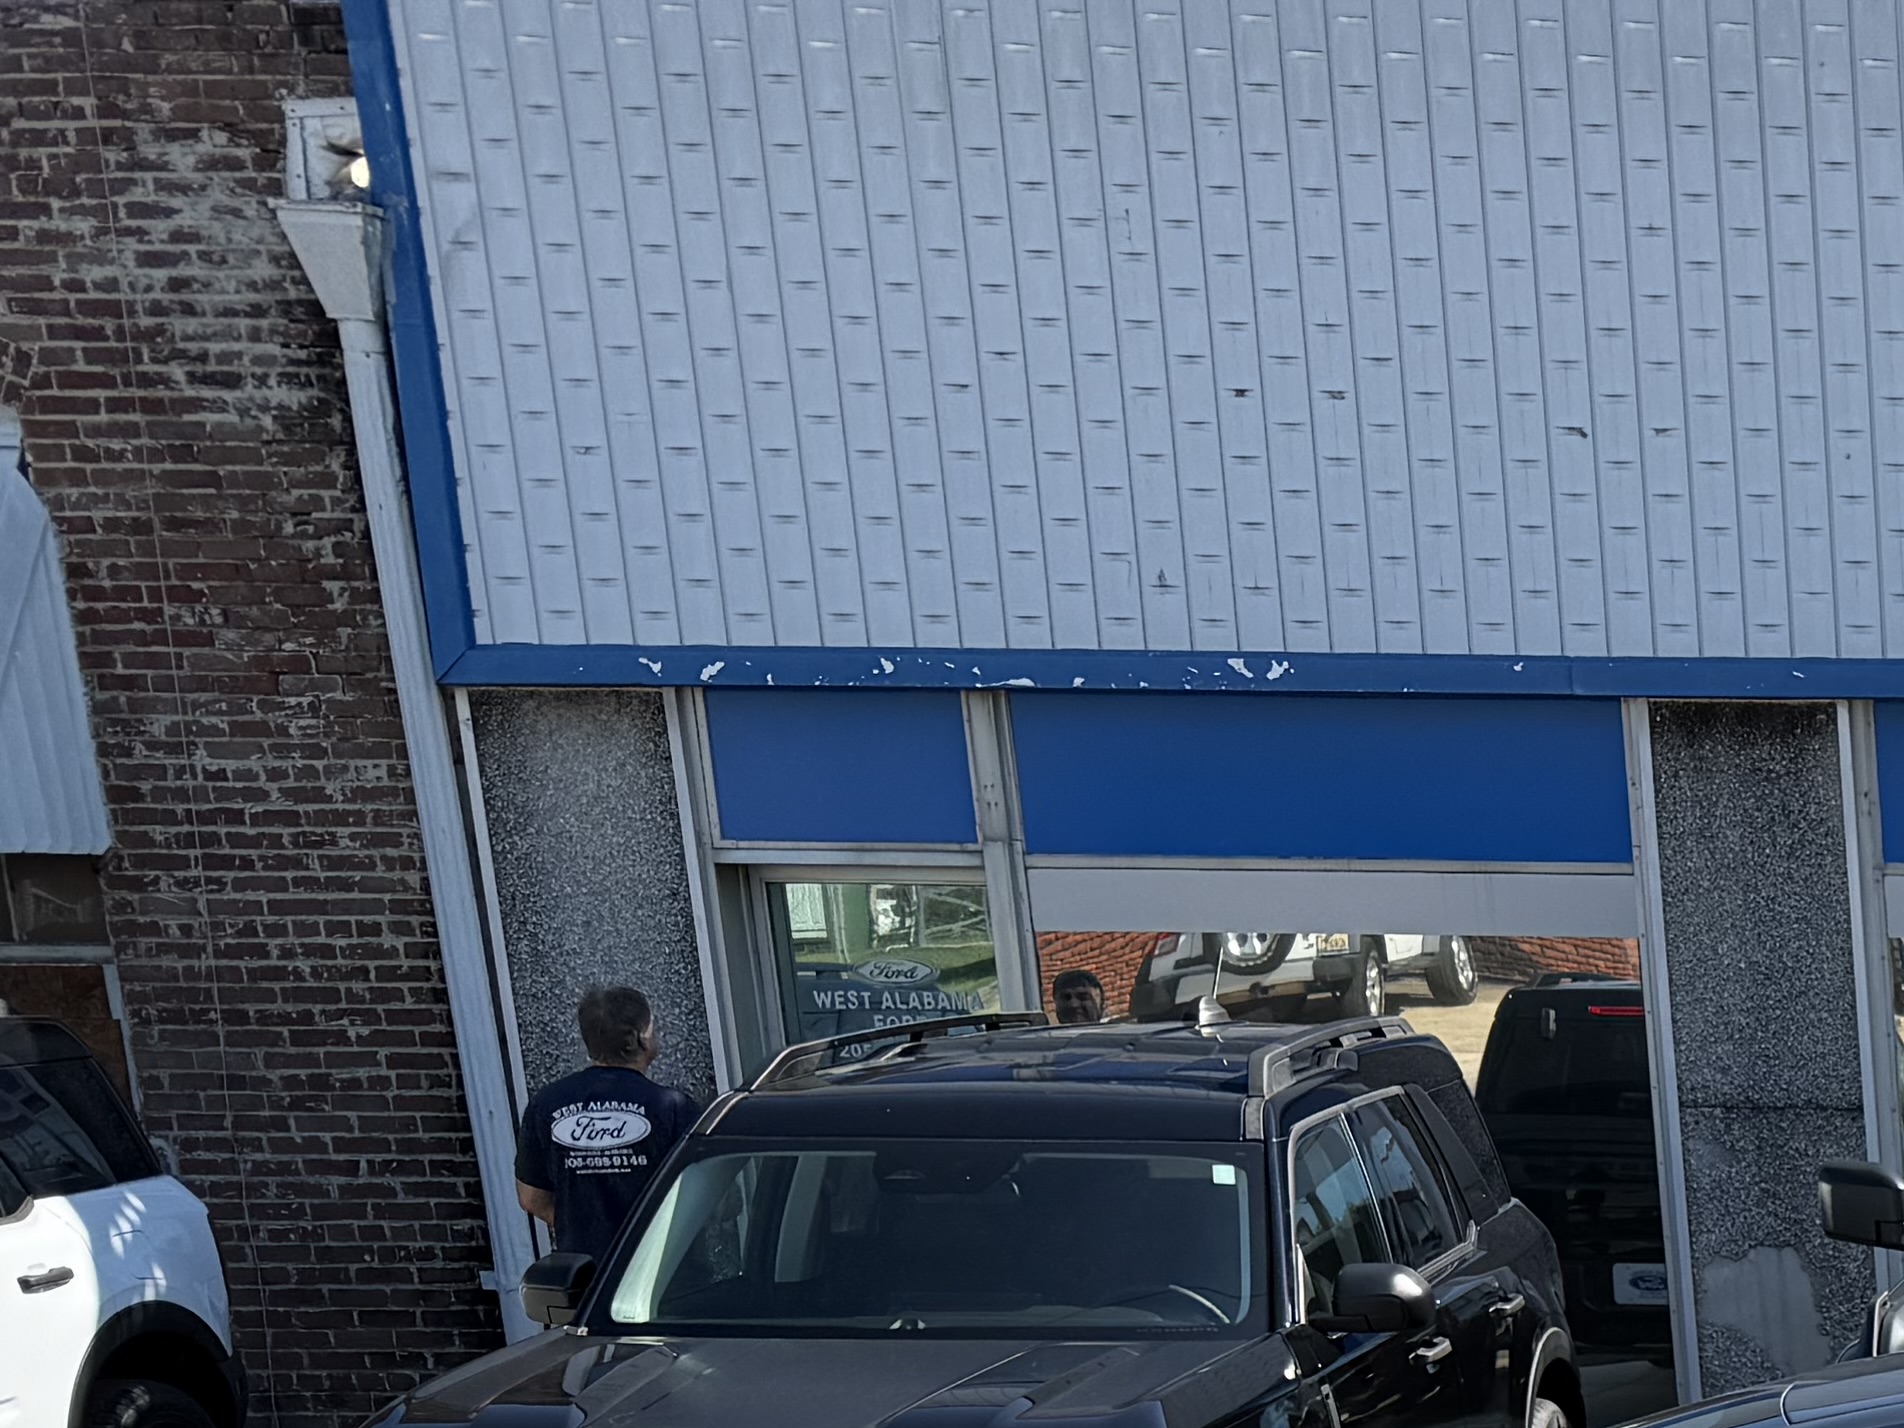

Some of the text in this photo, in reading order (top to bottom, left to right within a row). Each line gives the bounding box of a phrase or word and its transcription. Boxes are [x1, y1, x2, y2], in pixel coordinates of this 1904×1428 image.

[868, 960, 920, 980] Ford
[813, 990, 984, 1011] WEST ALABAMA
[571, 1115, 627, 1141] Ford
